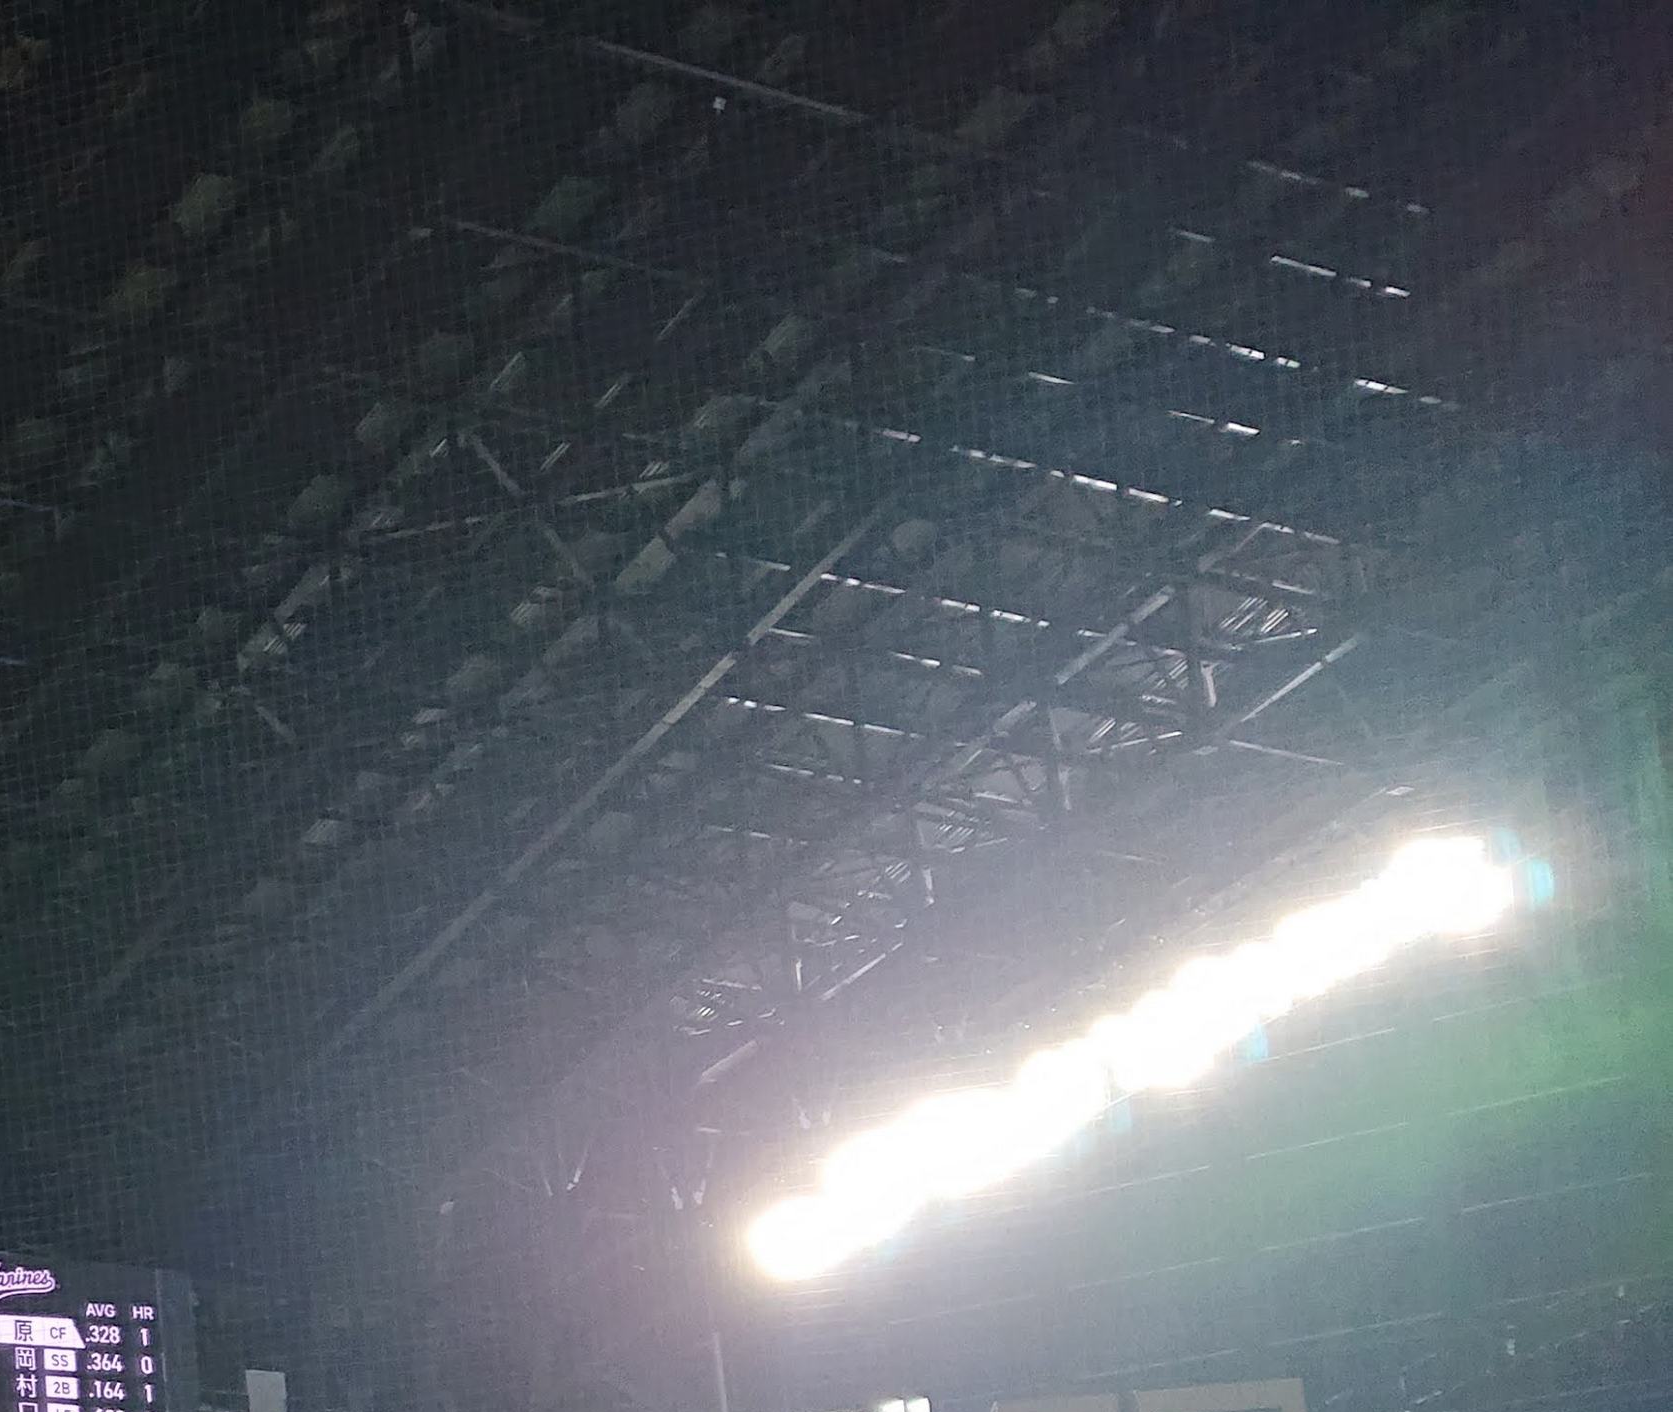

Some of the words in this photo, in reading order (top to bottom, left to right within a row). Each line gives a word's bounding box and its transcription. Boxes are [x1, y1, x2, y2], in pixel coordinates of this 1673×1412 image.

[86, 1303, 116, 1318] AVG
[132, 1306, 154, 1320] HR
[85, 1326, 121, 1345] .328
[86, 1353, 124, 1373] .364
